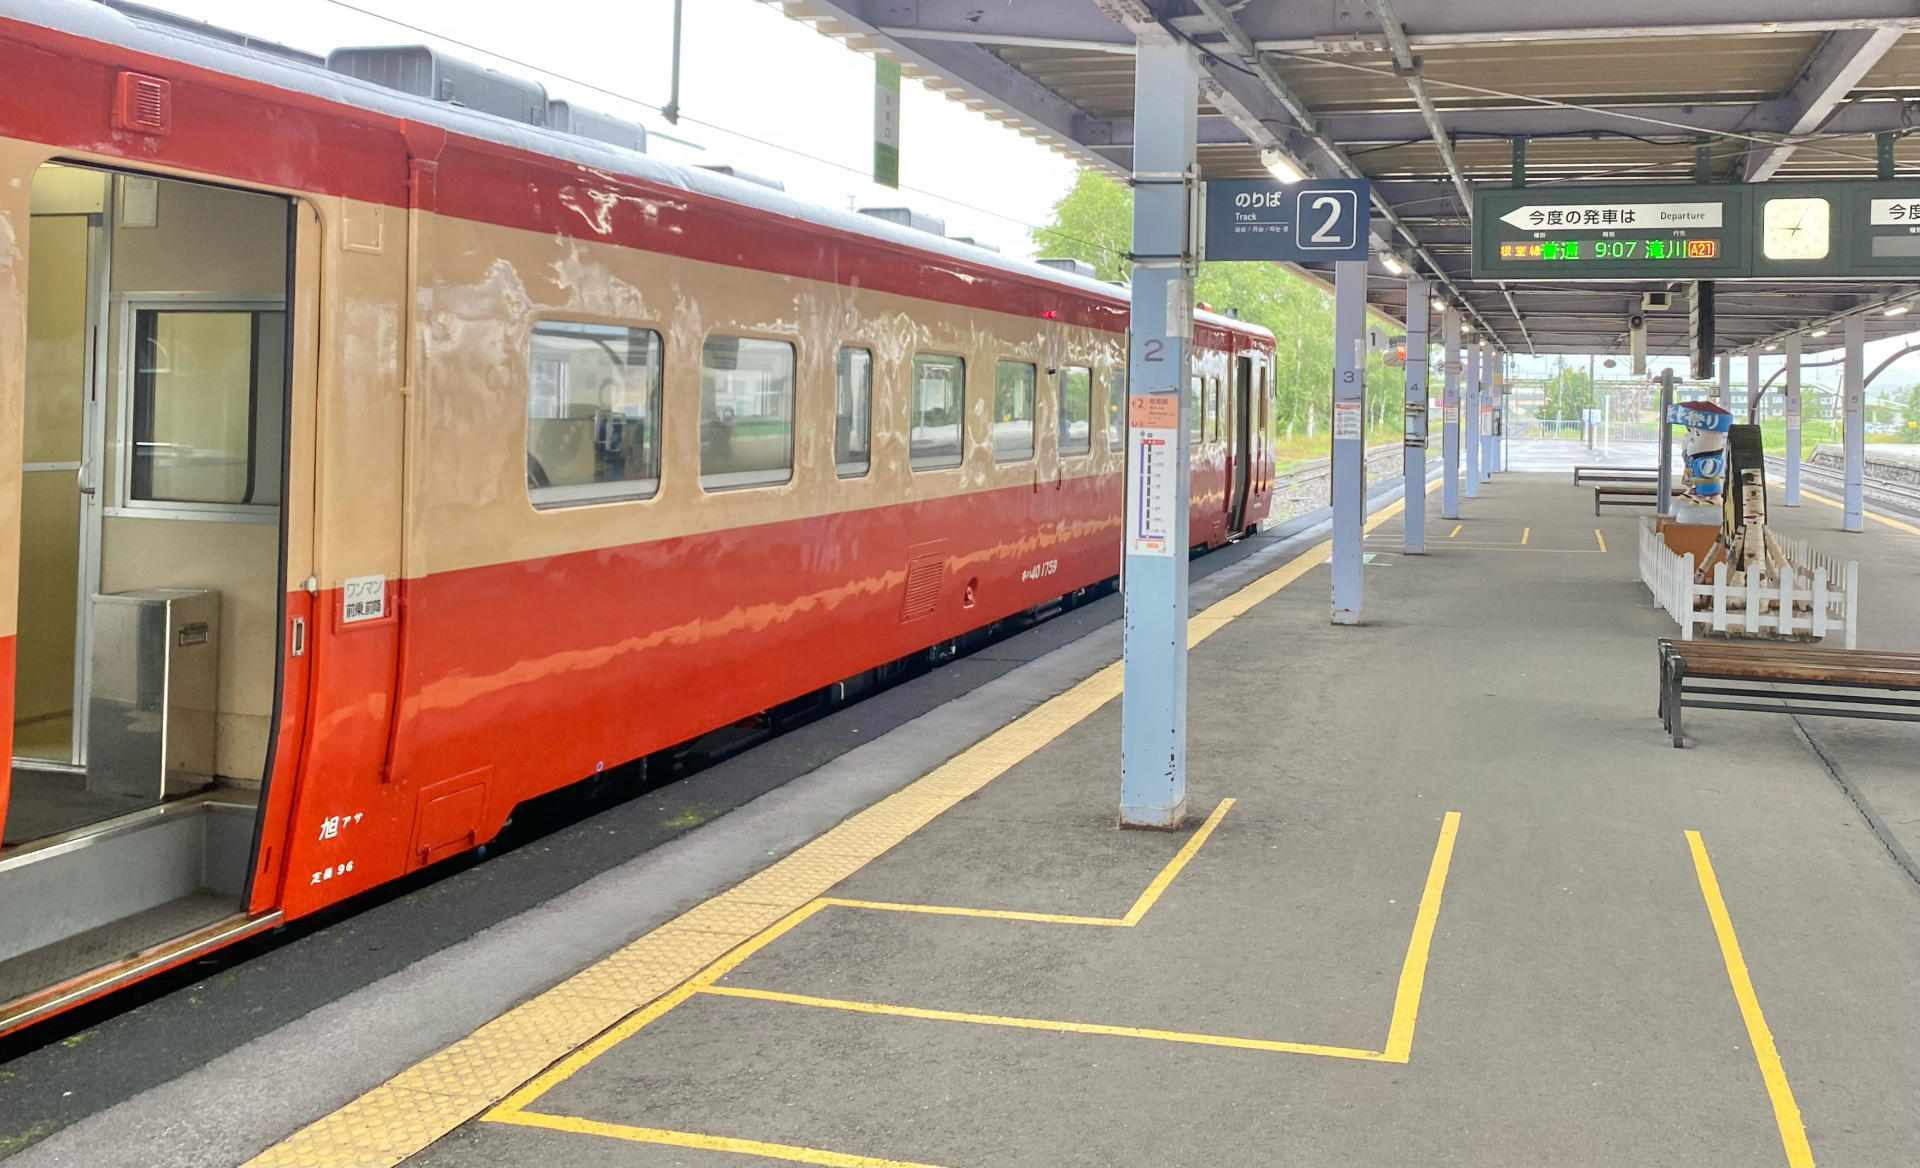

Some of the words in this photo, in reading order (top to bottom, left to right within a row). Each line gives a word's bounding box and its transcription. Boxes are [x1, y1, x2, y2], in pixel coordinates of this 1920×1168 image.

[1235, 191, 1282, 208] のりば
[1235, 212, 1257, 221] Track
[1310, 196, 1341, 243] 2
[1529, 209, 1636, 226] 今度の発車は
[1660, 211, 1706, 221] Departure
[1500, 244, 1541, 257] 根室線
[1541, 240, 1580, 260] 普通
[1594, 241, 1637, 259] 9:07
[1645, 239, 1687, 260] 滝川
[1690, 243, 1712, 256] A21
[1370, 332, 1376, 347] 1
[1144, 339, 1164, 362] 2
[1437, 363, 1444, 372] 2
[1343, 371, 1355, 383] 3
[1410, 383, 1419, 391] 4
[1137, 399, 1144, 409] 2
[1851, 395, 1859, 404] 5
[346, 580, 383, 598] ワンマン
[337, 860, 354, 876] 96
